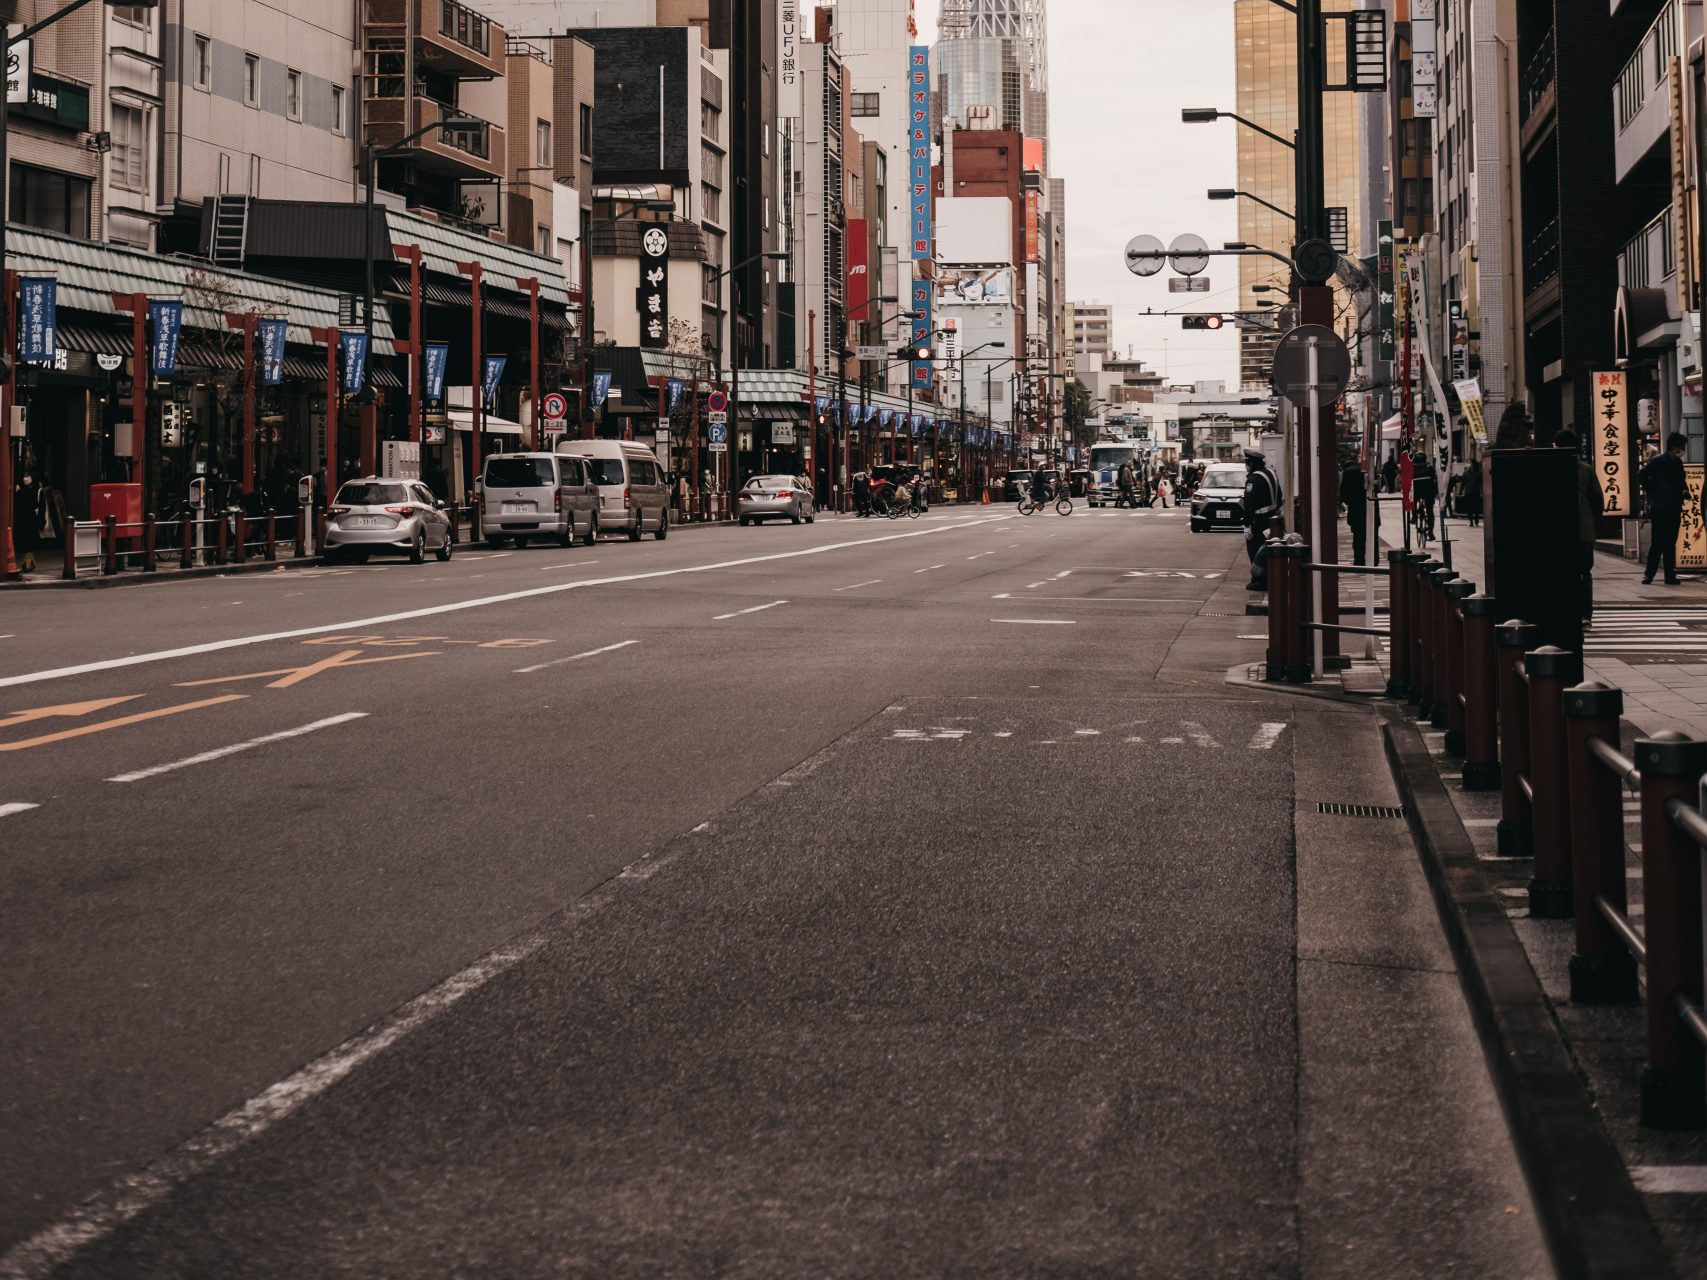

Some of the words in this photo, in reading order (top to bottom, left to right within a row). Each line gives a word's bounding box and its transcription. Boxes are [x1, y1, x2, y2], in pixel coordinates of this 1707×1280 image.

[914, 53, 927, 252] カラオケ&パーティー館
[849, 264, 866, 276] JTB
[157, 307, 171, 369] 新春浅草歌舞伎
[915, 289, 928, 381] カラオ館
[1600, 387, 1622, 513] 中華食堂日高屋
